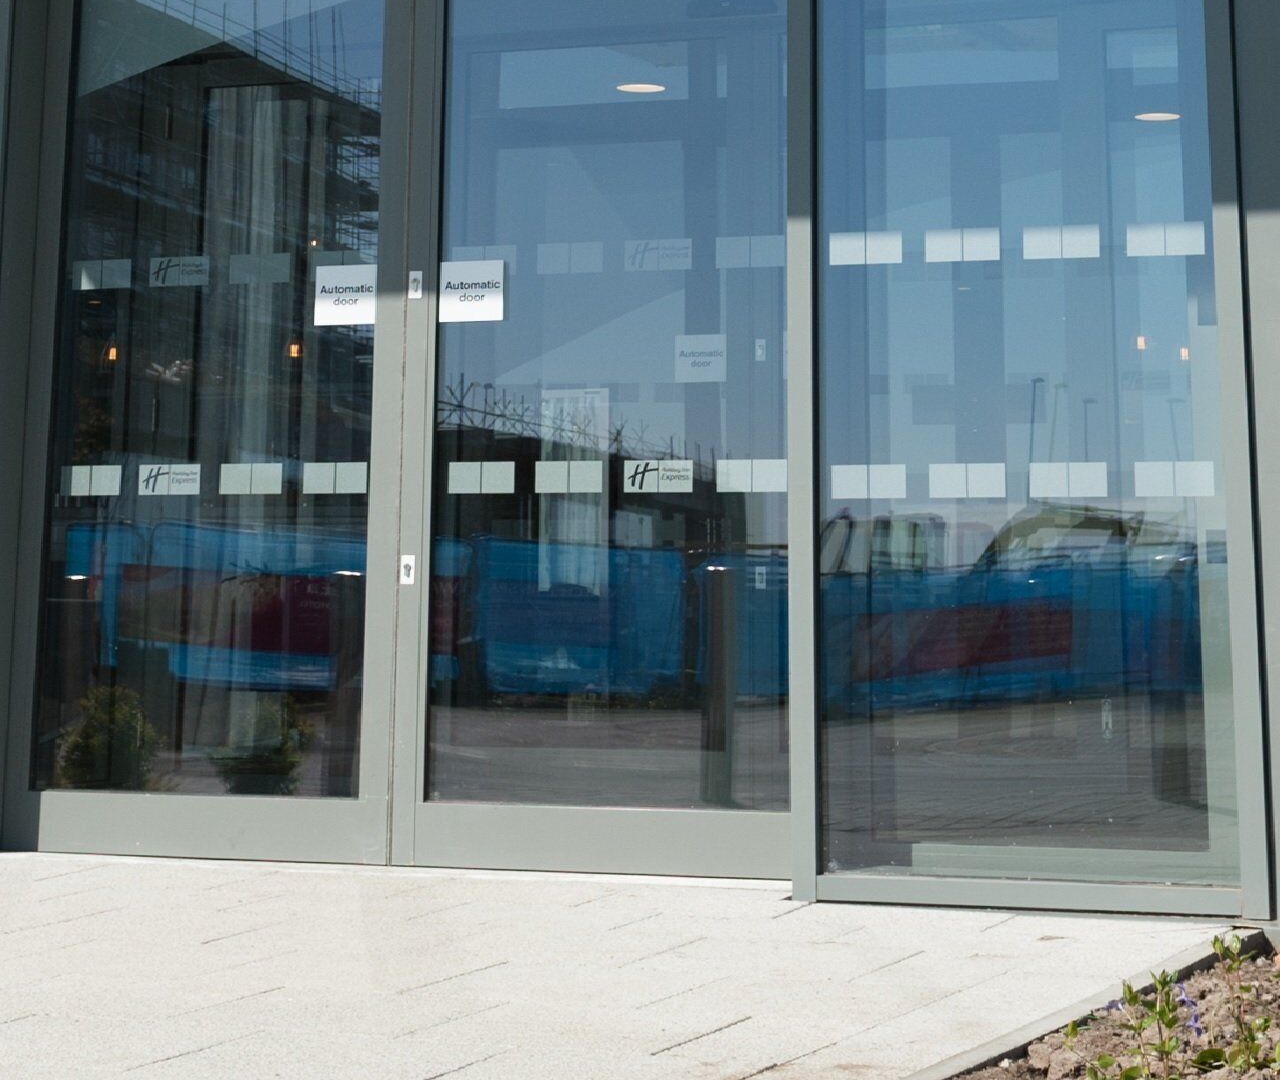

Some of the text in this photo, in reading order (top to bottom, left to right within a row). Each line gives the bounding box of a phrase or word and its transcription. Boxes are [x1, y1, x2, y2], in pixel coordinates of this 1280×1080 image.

[320, 283, 374, 295] Automatic
[445, 280, 501, 291] Automatic
[332, 297, 359, 306] door
[459, 292, 486, 302] door
[679, 349, 724, 359] Automatic
[690, 359, 712, 368] door
